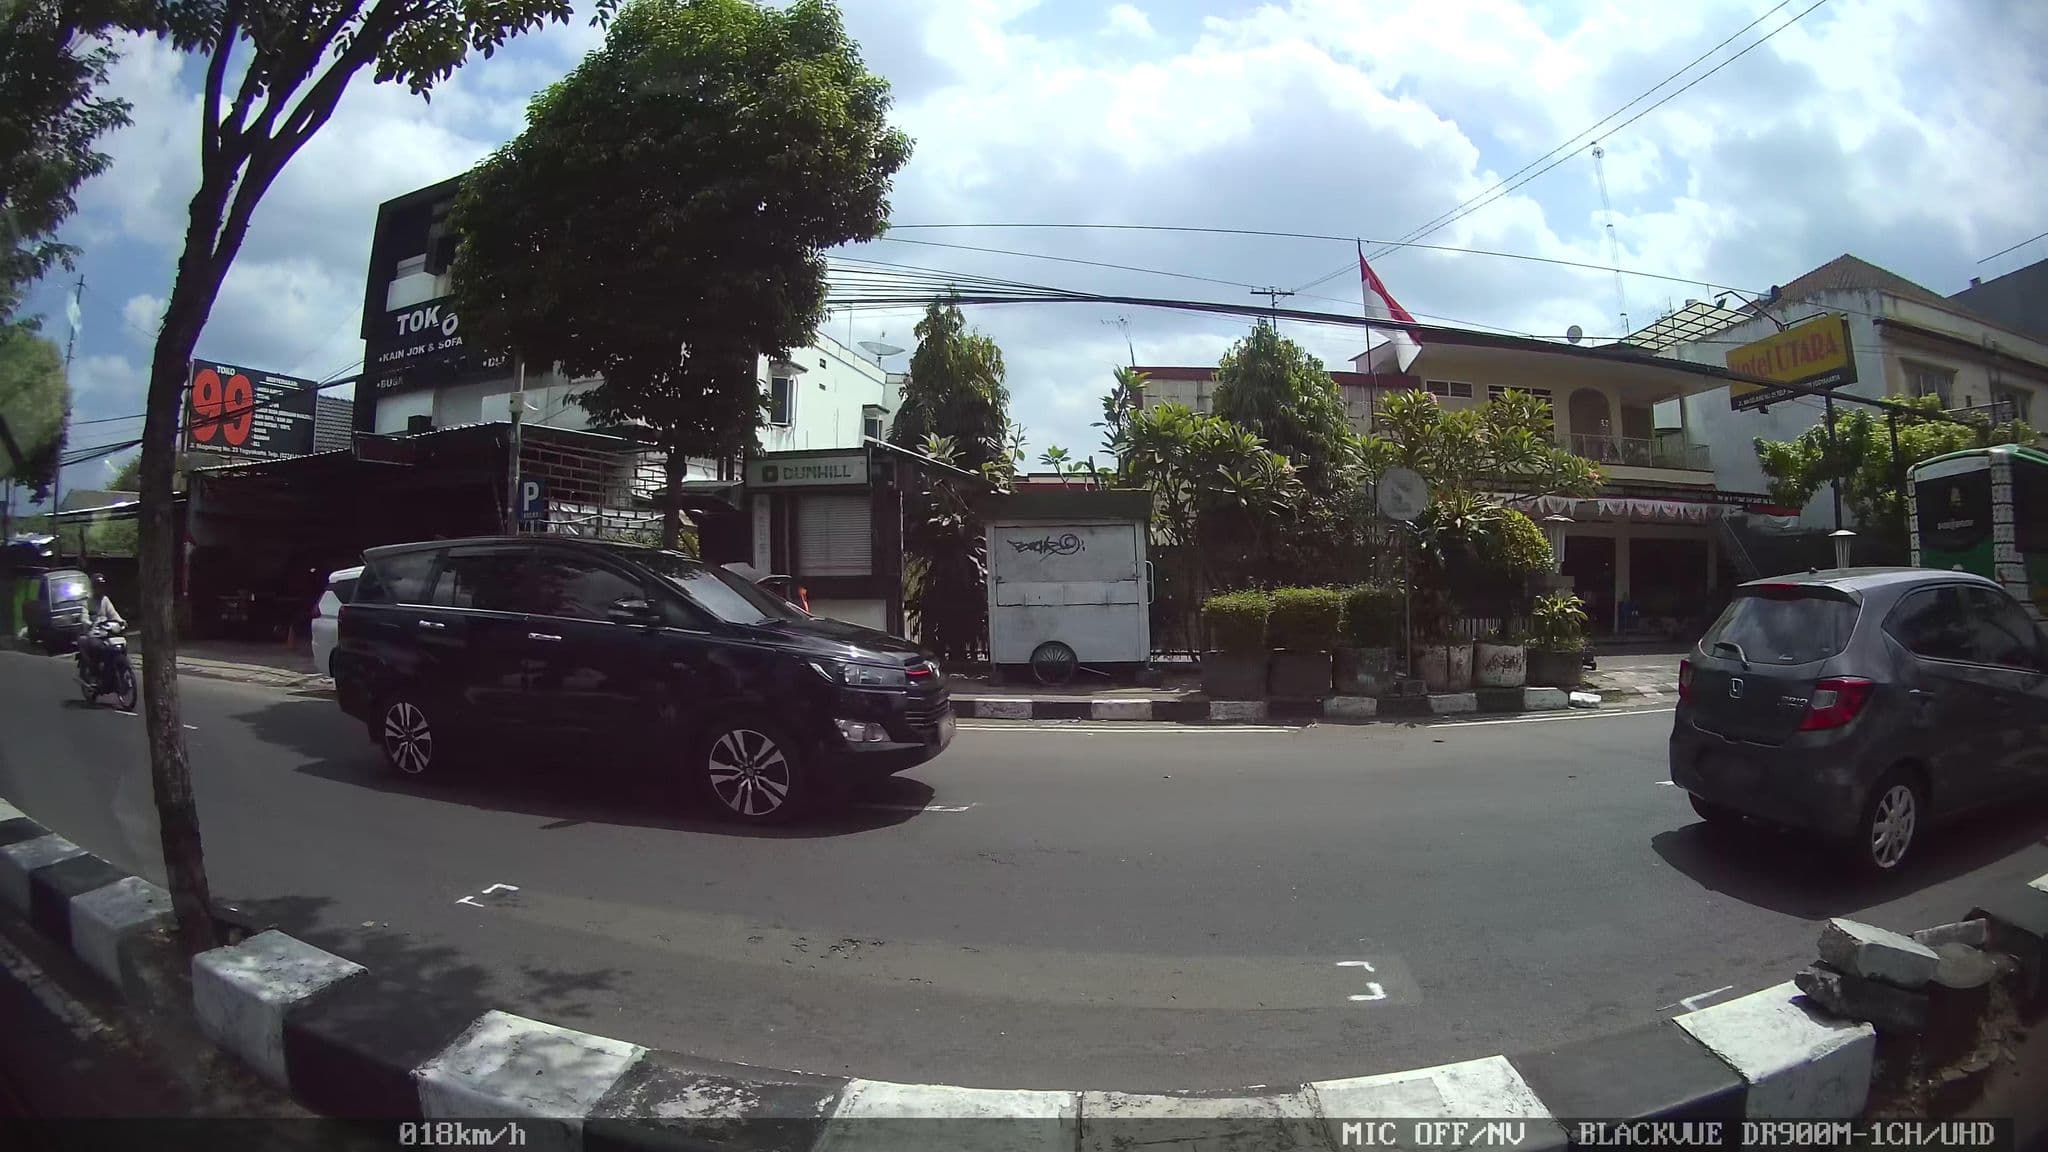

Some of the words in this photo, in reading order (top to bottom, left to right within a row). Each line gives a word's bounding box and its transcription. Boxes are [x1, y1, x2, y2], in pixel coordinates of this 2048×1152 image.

[397, 304, 459, 337] TOKO
[382, 349, 404, 362] KAIN
[406, 344, 426, 358] JOK
[427, 342, 436, 353] &
[438, 336, 463, 350] SOFA
[1730, 348, 1773, 378] Hotel
[192, 368, 253, 447] 99
[783, 464, 851, 481] DUNHILL
[523, 481, 540, 512] P
